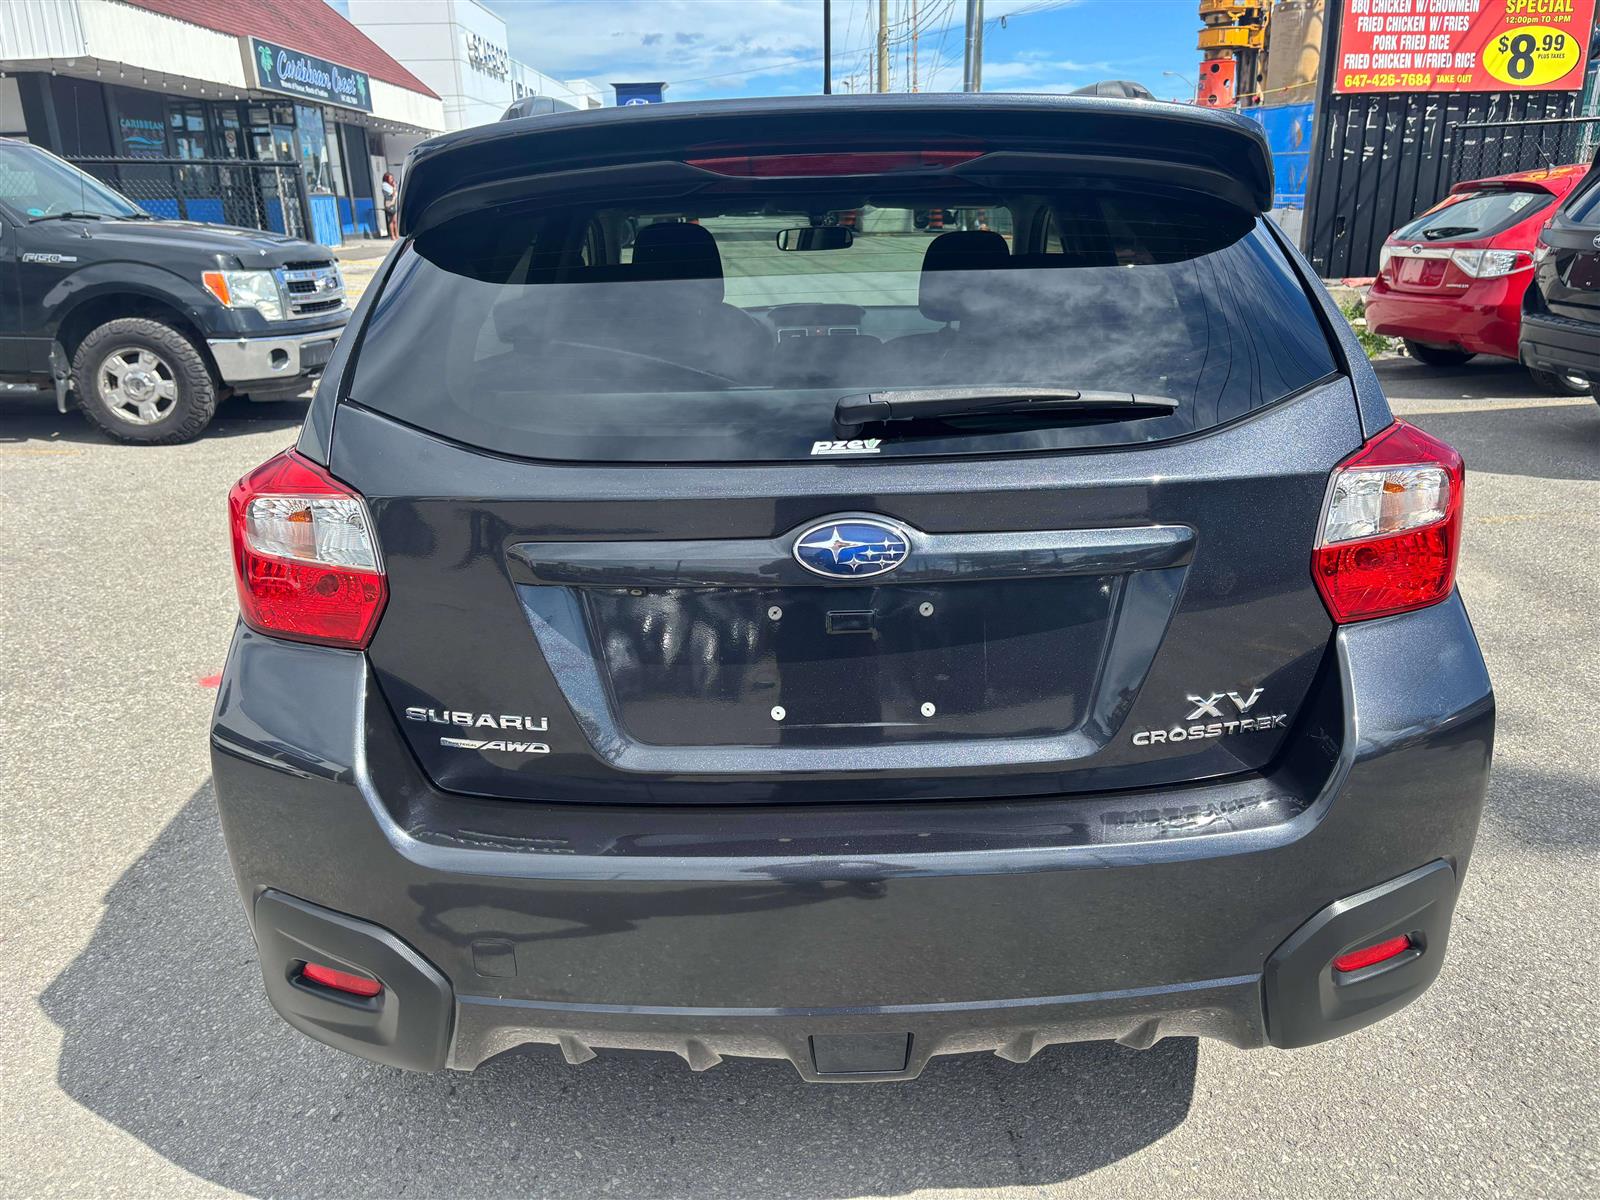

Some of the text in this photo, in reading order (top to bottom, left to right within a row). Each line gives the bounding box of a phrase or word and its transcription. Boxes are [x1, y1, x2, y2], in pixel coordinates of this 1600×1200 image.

[1351, 0, 1369, 15] BBQ
[1372, 0, 1412, 13] CHICKEN
[1505, 0, 1574, 13] SPECIAL
[1357, 16, 1384, 32] FRIED
[1386, 16, 1426, 32] CHICKEN
[1505, 15, 1572, 24] 12:00pm TO 4PM
[1373, 34, 1450, 50] PORK FRIED RICE
[1343, 53, 1370, 69] FRIED
[1372, 53, 1411, 69] CHICKEN
[1455, 52, 1476, 68] RICE
[276, 50, 331, 90] Caribbean
[1344, 73, 1472, 87] 647-426-7684 TAKE OUT
[1185, 687, 1265, 721] XV
[405, 707, 548, 731] SUBARU
[1132, 713, 1288, 746] CROSSTREK
[480, 740, 551, 754] AWD
